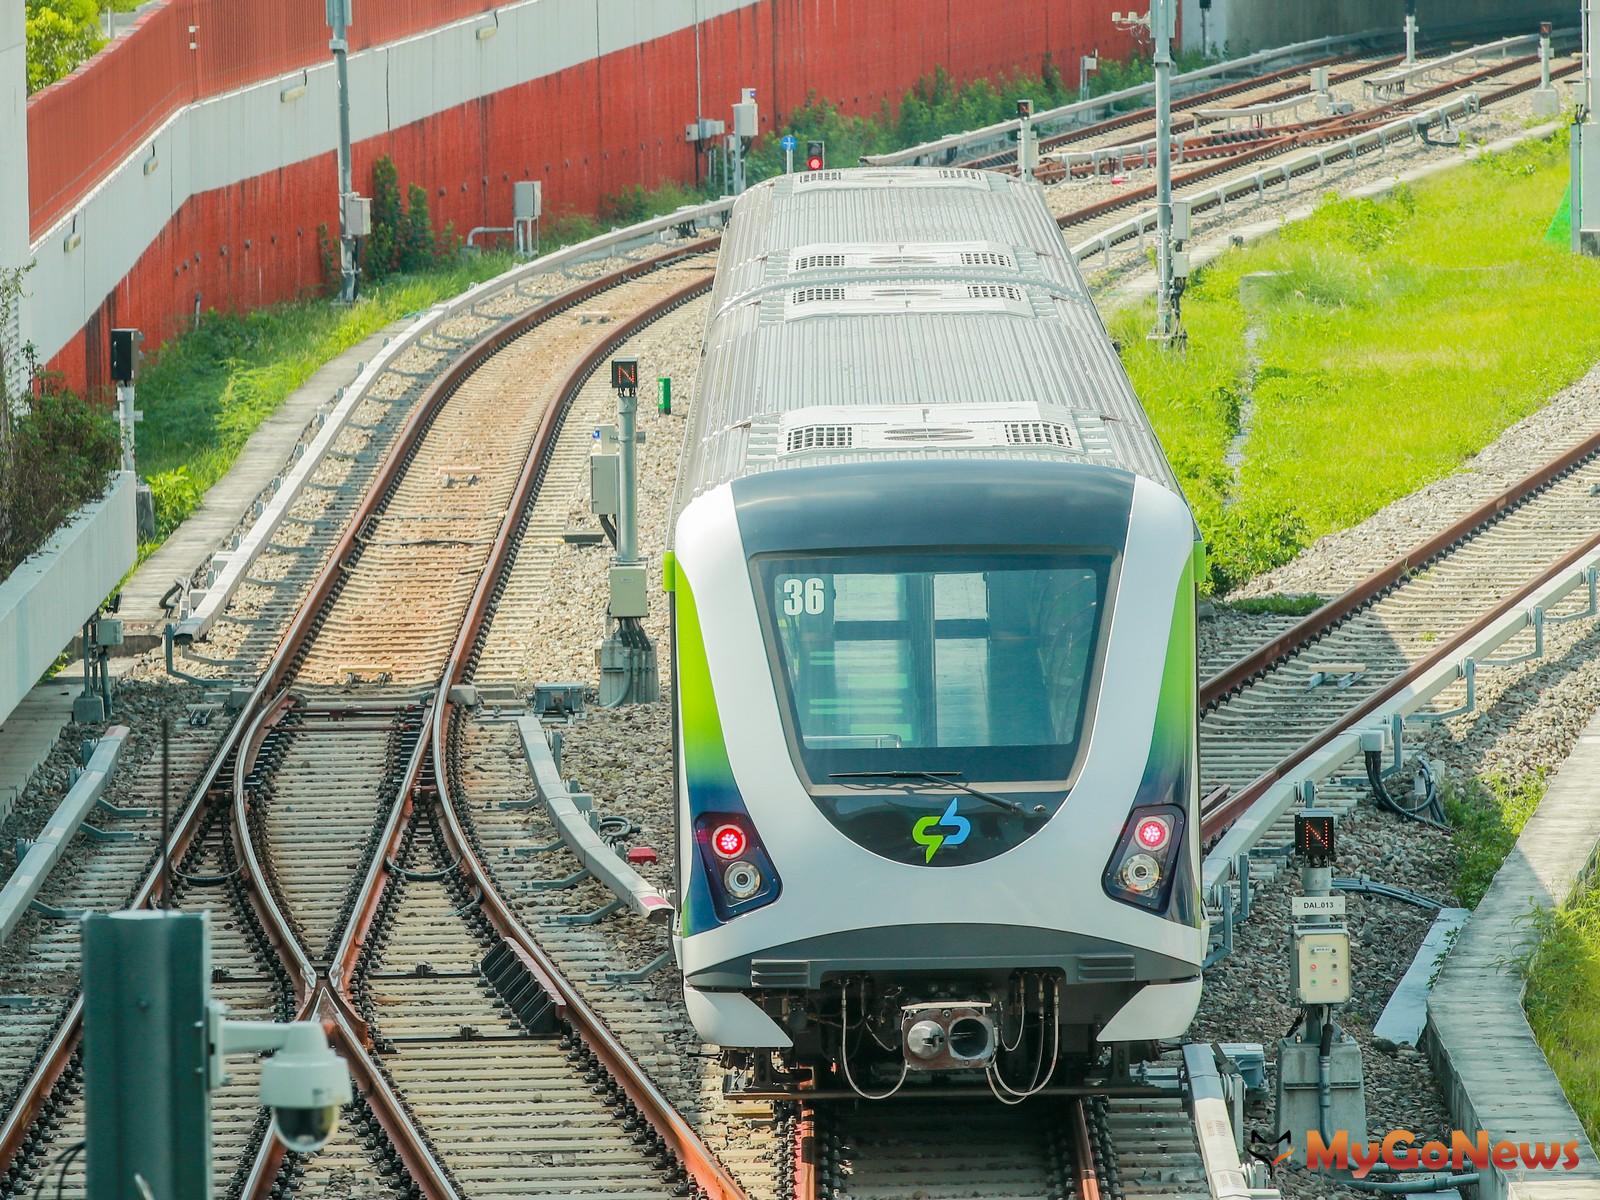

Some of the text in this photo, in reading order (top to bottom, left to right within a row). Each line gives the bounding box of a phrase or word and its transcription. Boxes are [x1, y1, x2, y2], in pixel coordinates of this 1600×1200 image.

[618, 364, 635, 385] N
[783, 577, 825, 616] 36
[1305, 820, 1329, 850] N
